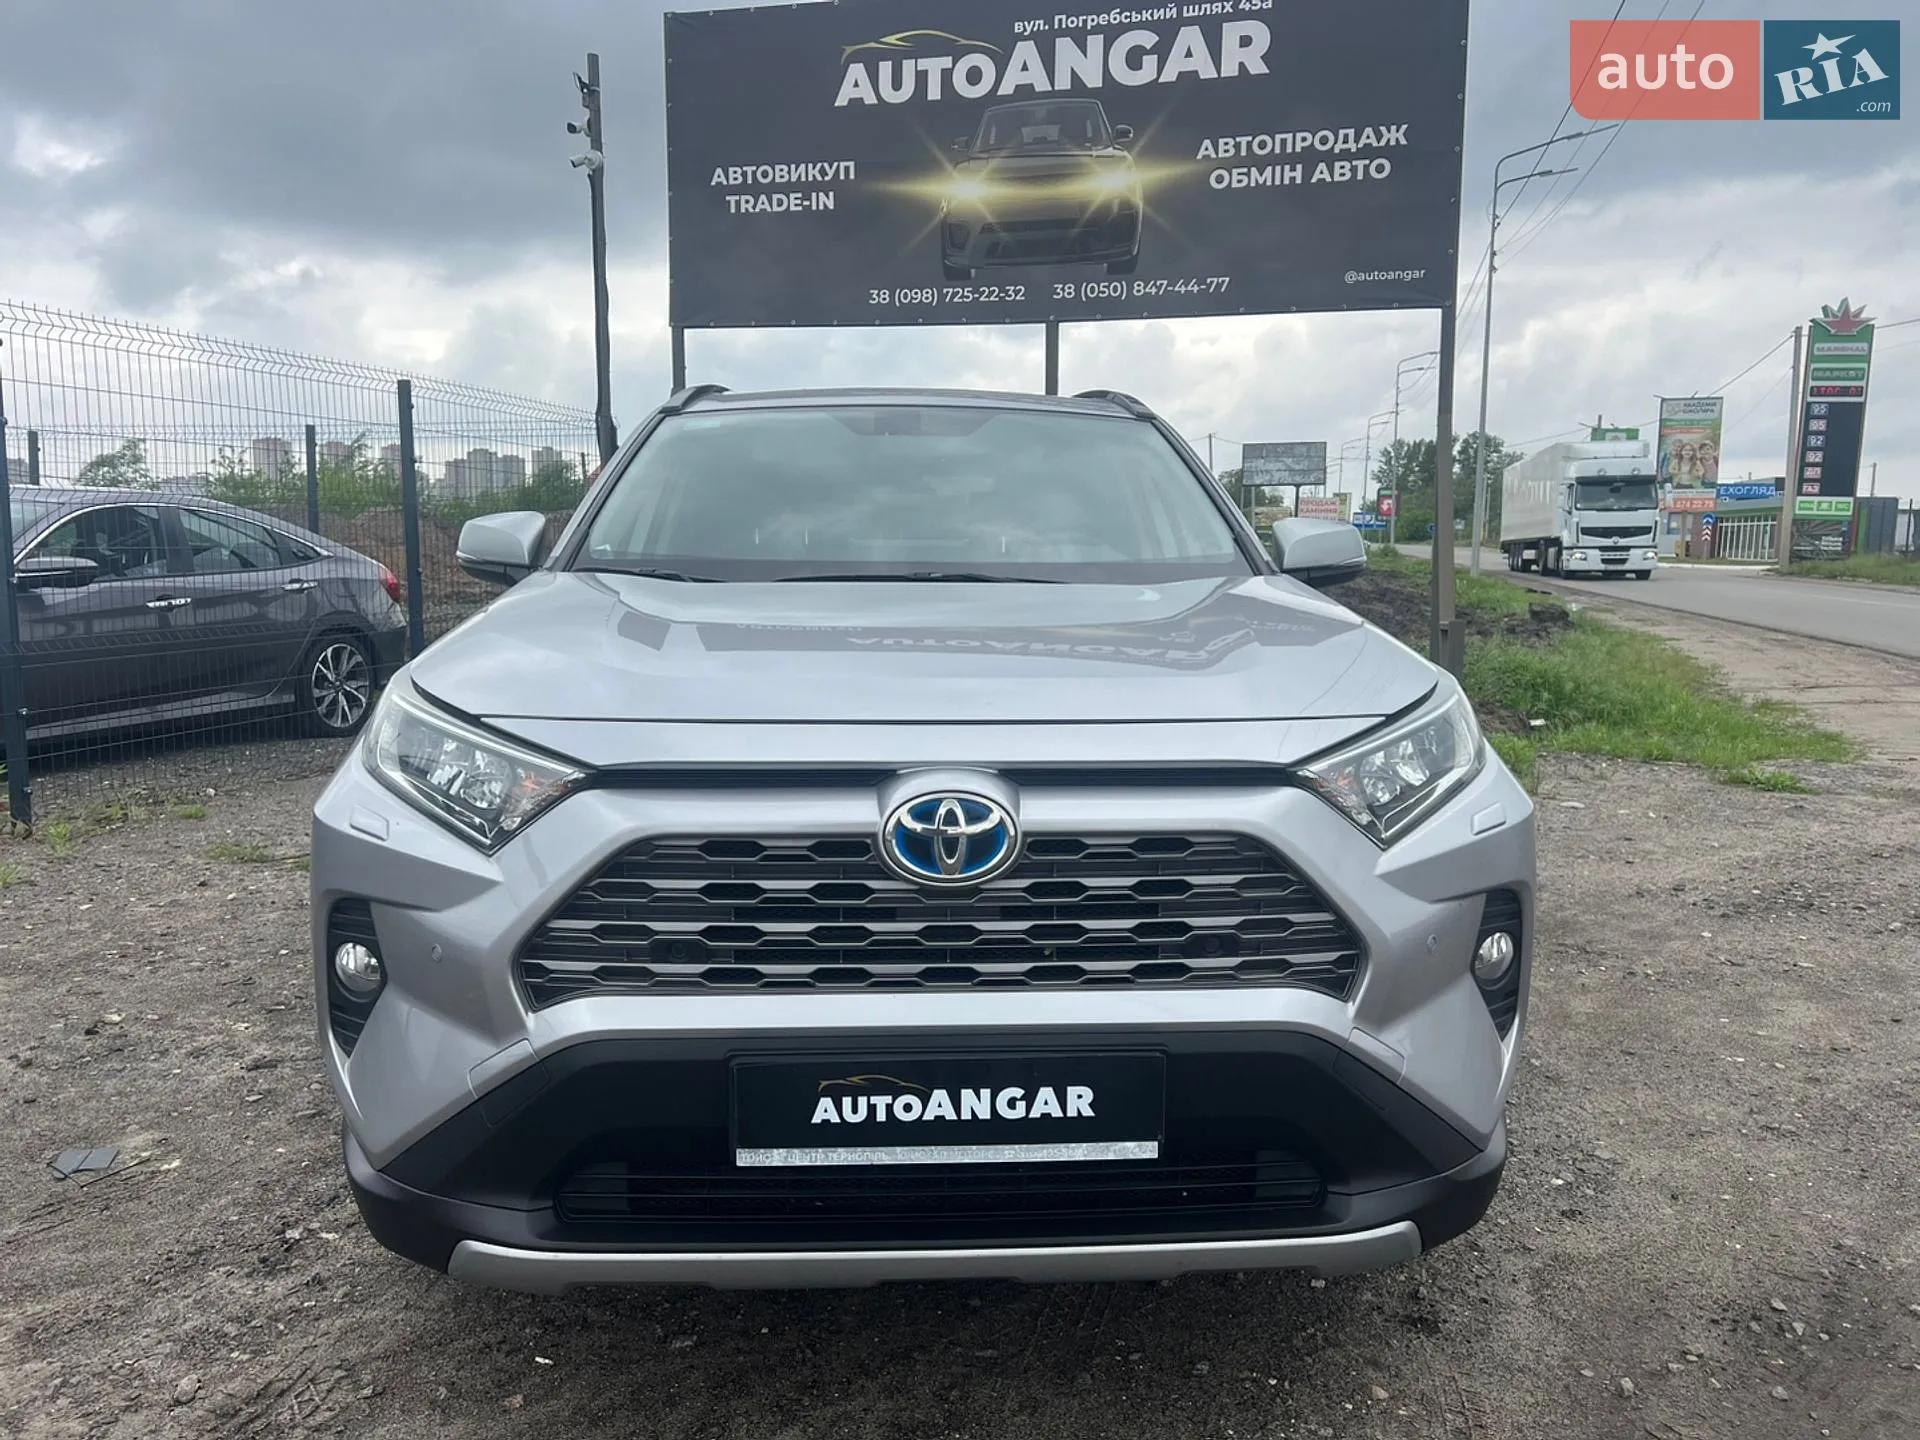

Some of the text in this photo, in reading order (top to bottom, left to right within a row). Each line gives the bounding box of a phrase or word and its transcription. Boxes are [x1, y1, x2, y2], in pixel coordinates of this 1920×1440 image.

[1014, 20, 1049, 35] вул.
[1054, 3, 1177, 31] Погребський
[1182, 2, 1233, 19] шлях
[834, 20, 1271, 107] AUTOANGAR
[1196, 124, 1408, 160] АВТОПРОДАЖ
[710, 160, 856, 186] АВТОВИКУП
[1209, 157, 1392, 190] ОБМІН АВТО
[725, 191, 835, 213] TRADE-IN
[868, 277, 1231, 306] 38 (098) 725-22-32 38 (050) 847-44-77
[1344, 269, 1426, 284] @autoangar
[1717, 486, 1776, 497] ЕХОГЛЯД
[810, 1086, 1096, 1124] AUTOANGAR
